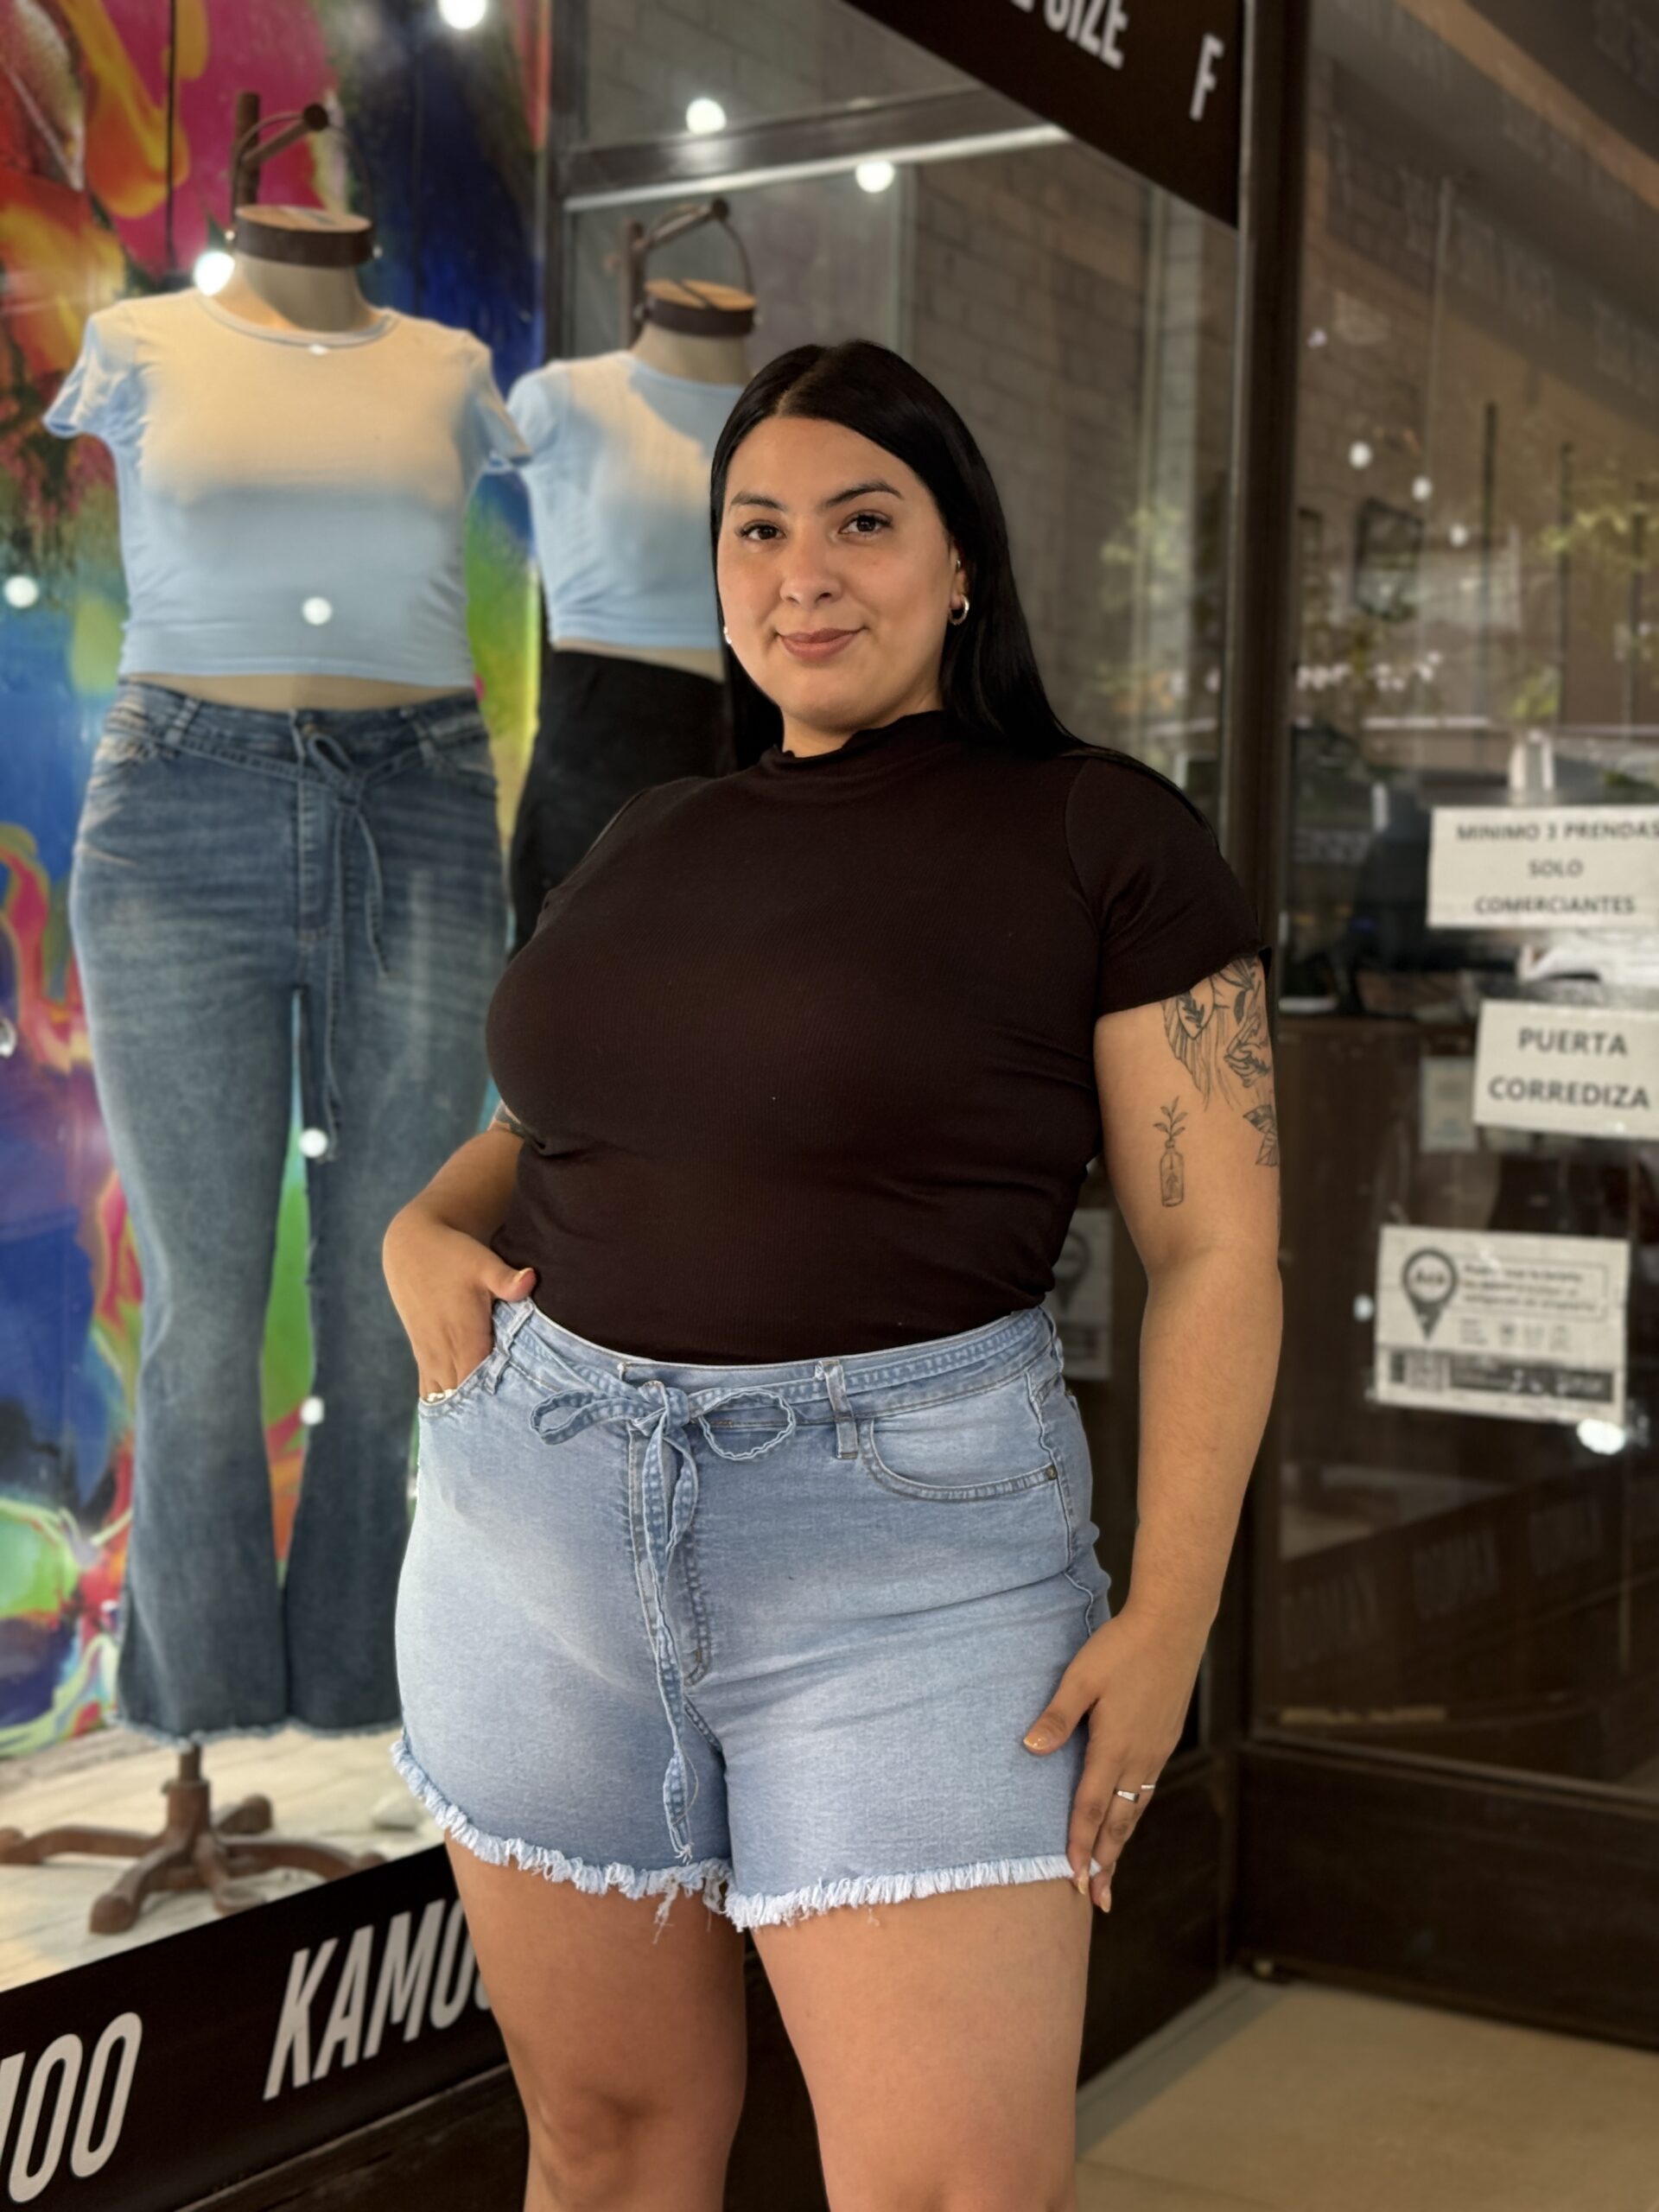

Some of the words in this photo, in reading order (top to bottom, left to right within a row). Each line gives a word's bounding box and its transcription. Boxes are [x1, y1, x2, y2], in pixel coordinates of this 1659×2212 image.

[1190, 33, 1224, 121] F
[1457, 823, 1541, 841] MINIMO
[1564, 821, 1659, 839] PRENDAS
[1528, 859, 1584, 878] SOLO
[1474, 895, 1636, 915] COMERCIANTES
[1518, 1027, 1628, 1057] PUERTA
[1488, 1077, 1650, 1109] CORREDIZA
[263, 1898, 492, 2101] KAMO
